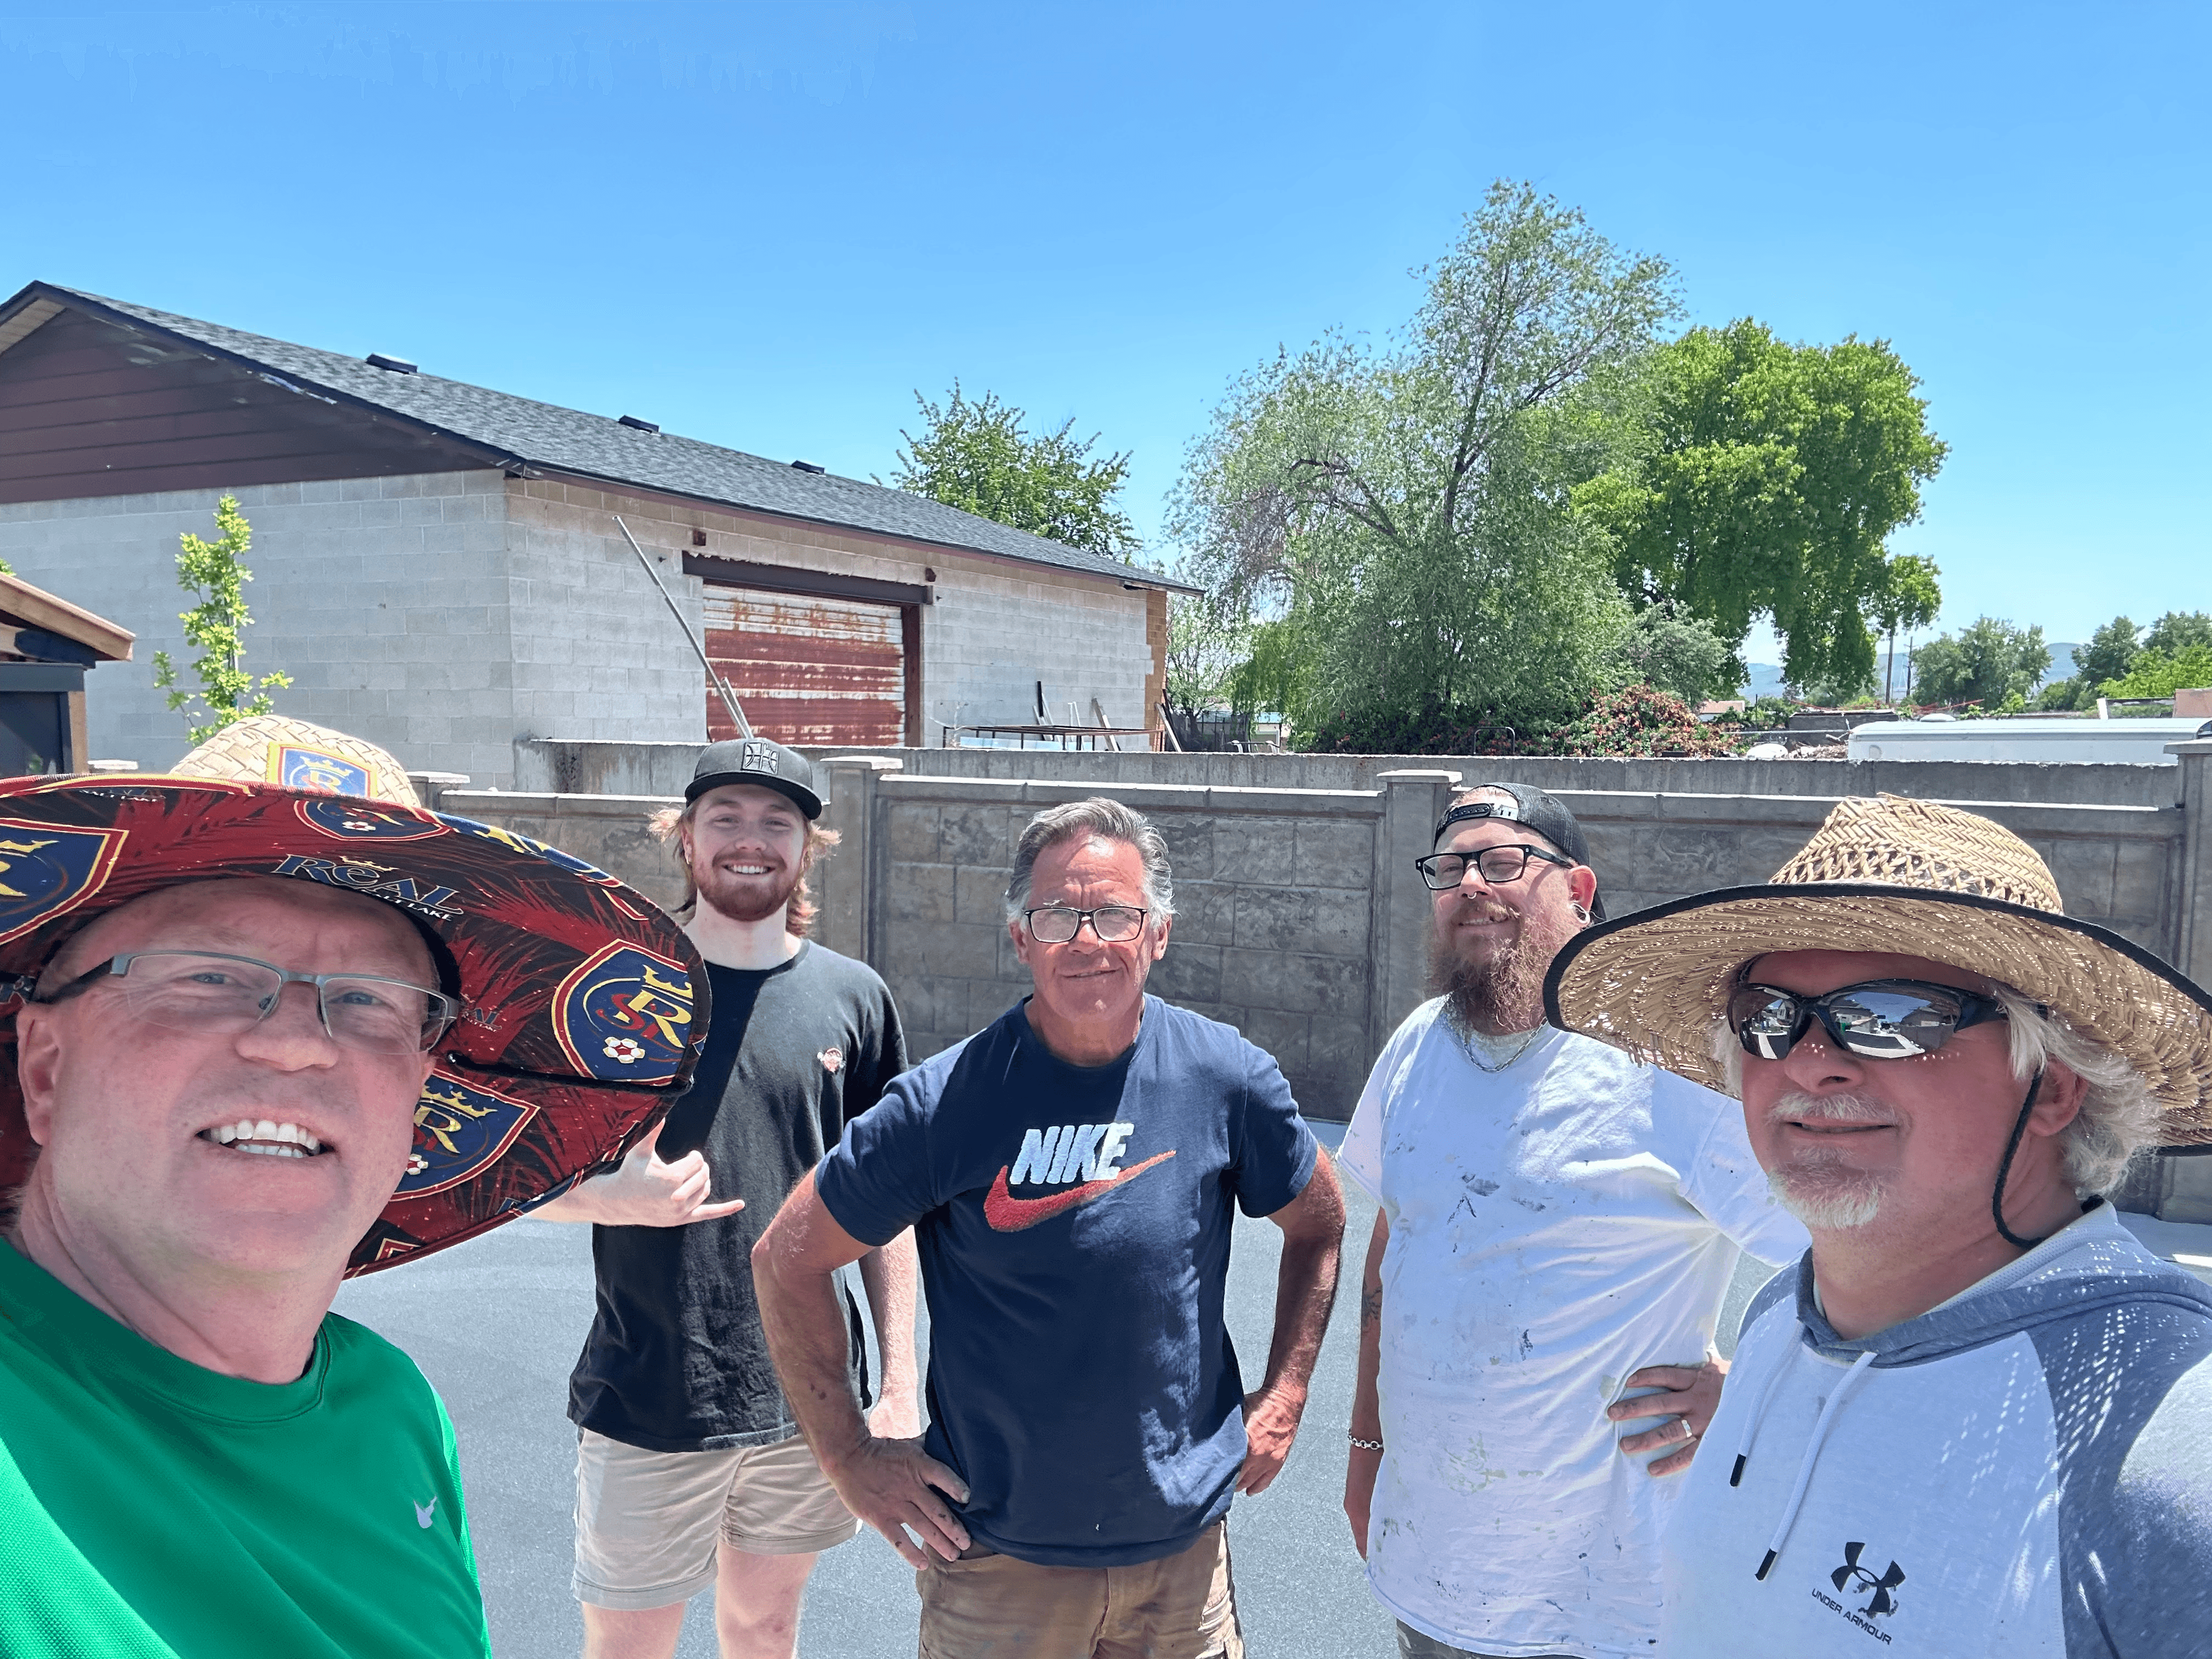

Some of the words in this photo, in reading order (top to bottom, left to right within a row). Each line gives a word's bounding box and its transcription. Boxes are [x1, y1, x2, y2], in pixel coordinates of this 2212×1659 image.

[407, 903, 453, 921] LAKE
[1009, 1123, 1135, 1185] NIKE
[1812, 1588, 1843, 1614] UNDER
[1843, 1611, 1892, 1646] ARMOUR
